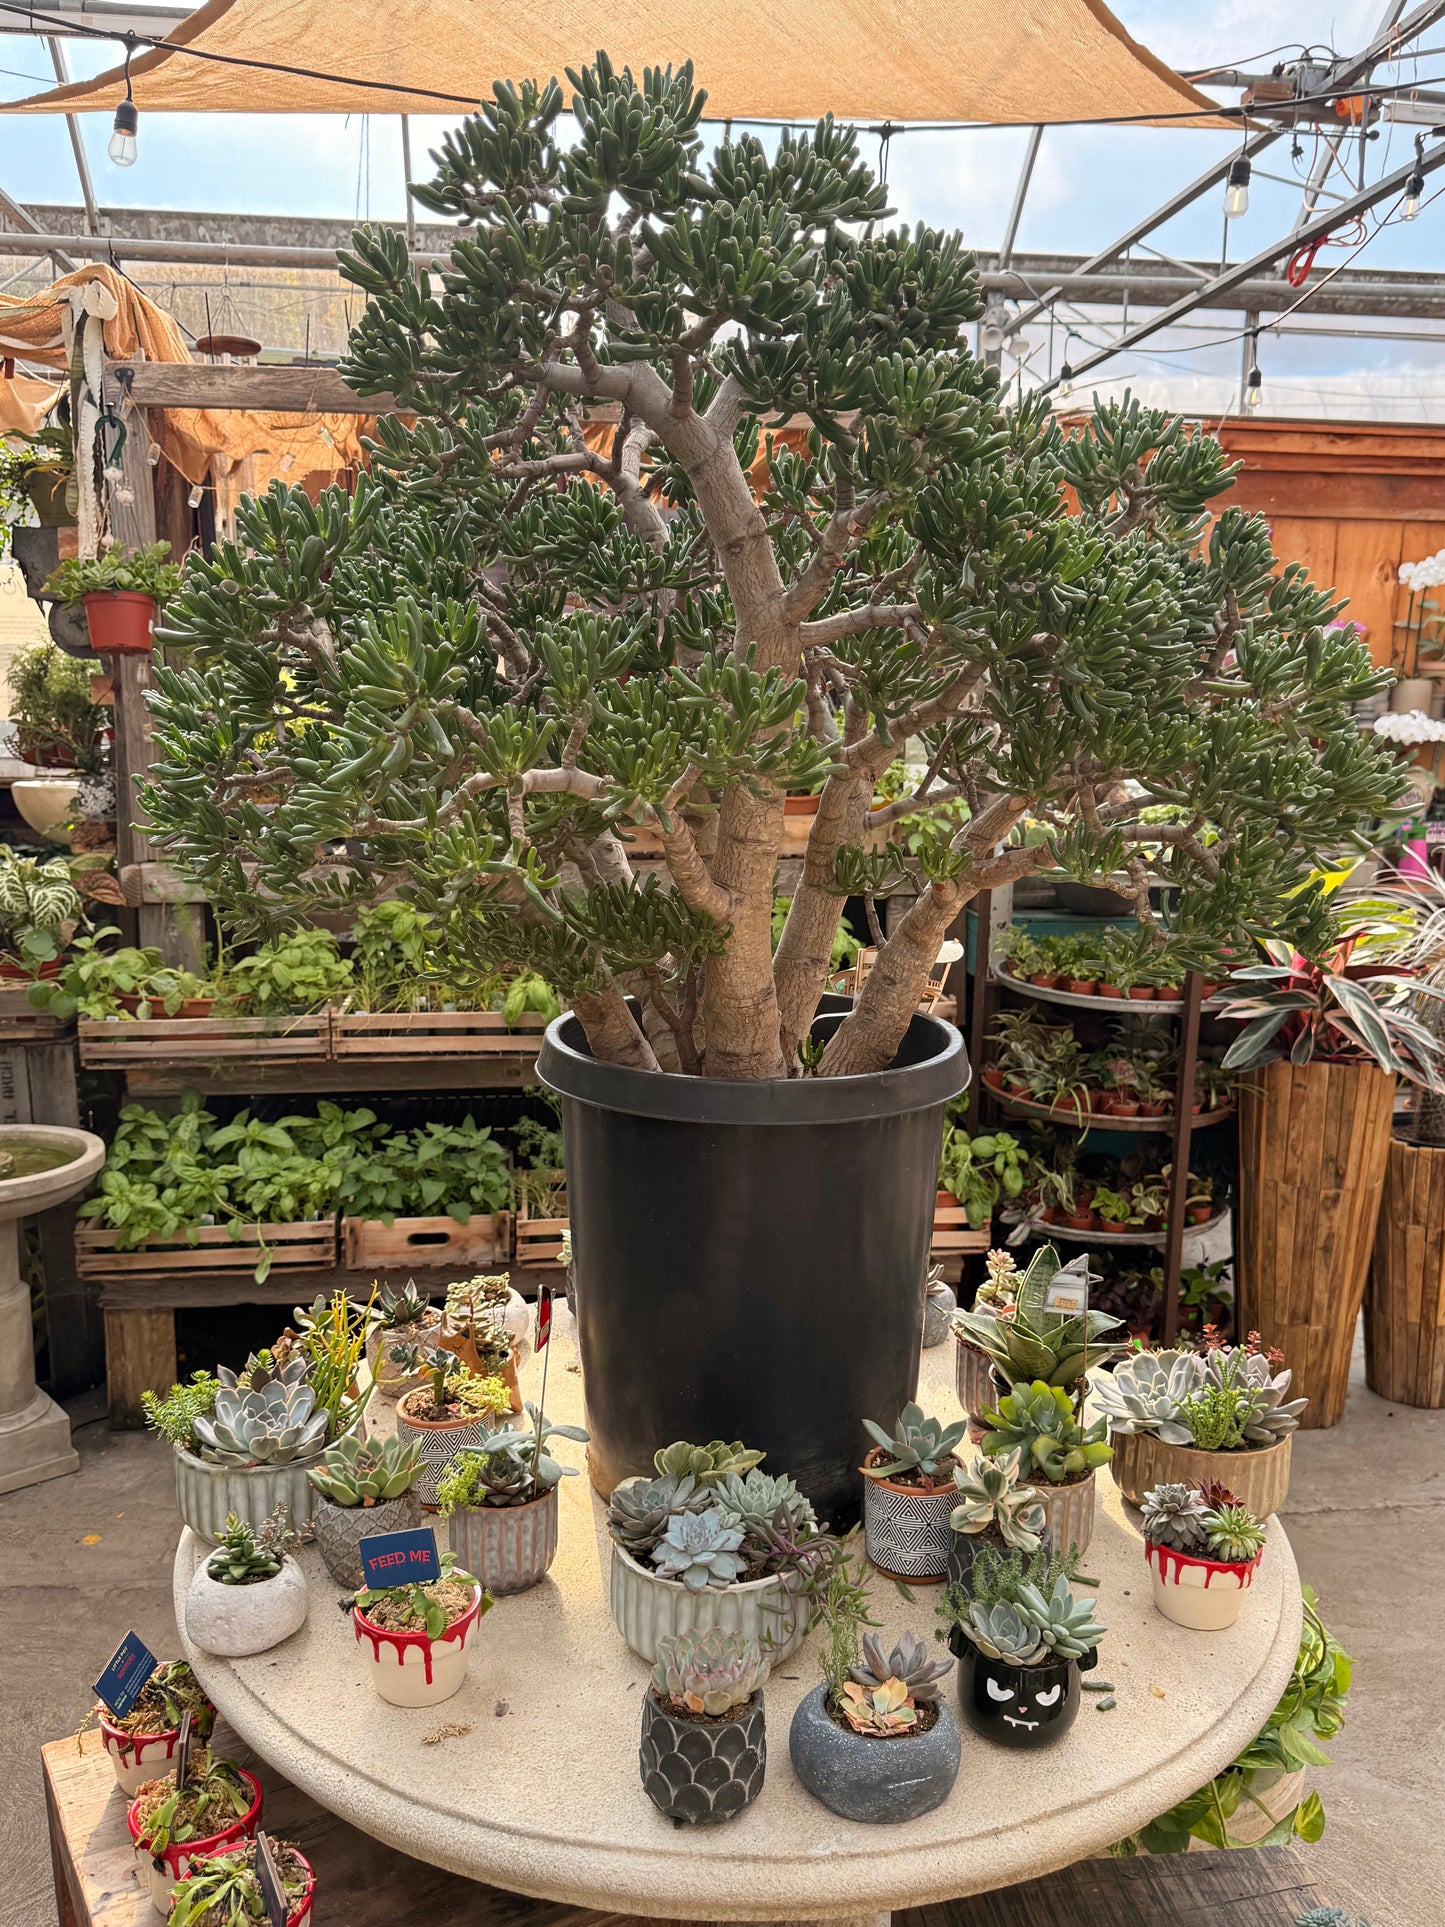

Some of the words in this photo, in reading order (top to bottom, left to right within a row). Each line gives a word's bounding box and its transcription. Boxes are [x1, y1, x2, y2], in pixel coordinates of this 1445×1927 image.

[368, 1551, 406, 1571] FEED
[409, 1550, 431, 1563] ME
[111, 1657, 122, 1672] LITTLE
[120, 1646, 128, 1657] POT
